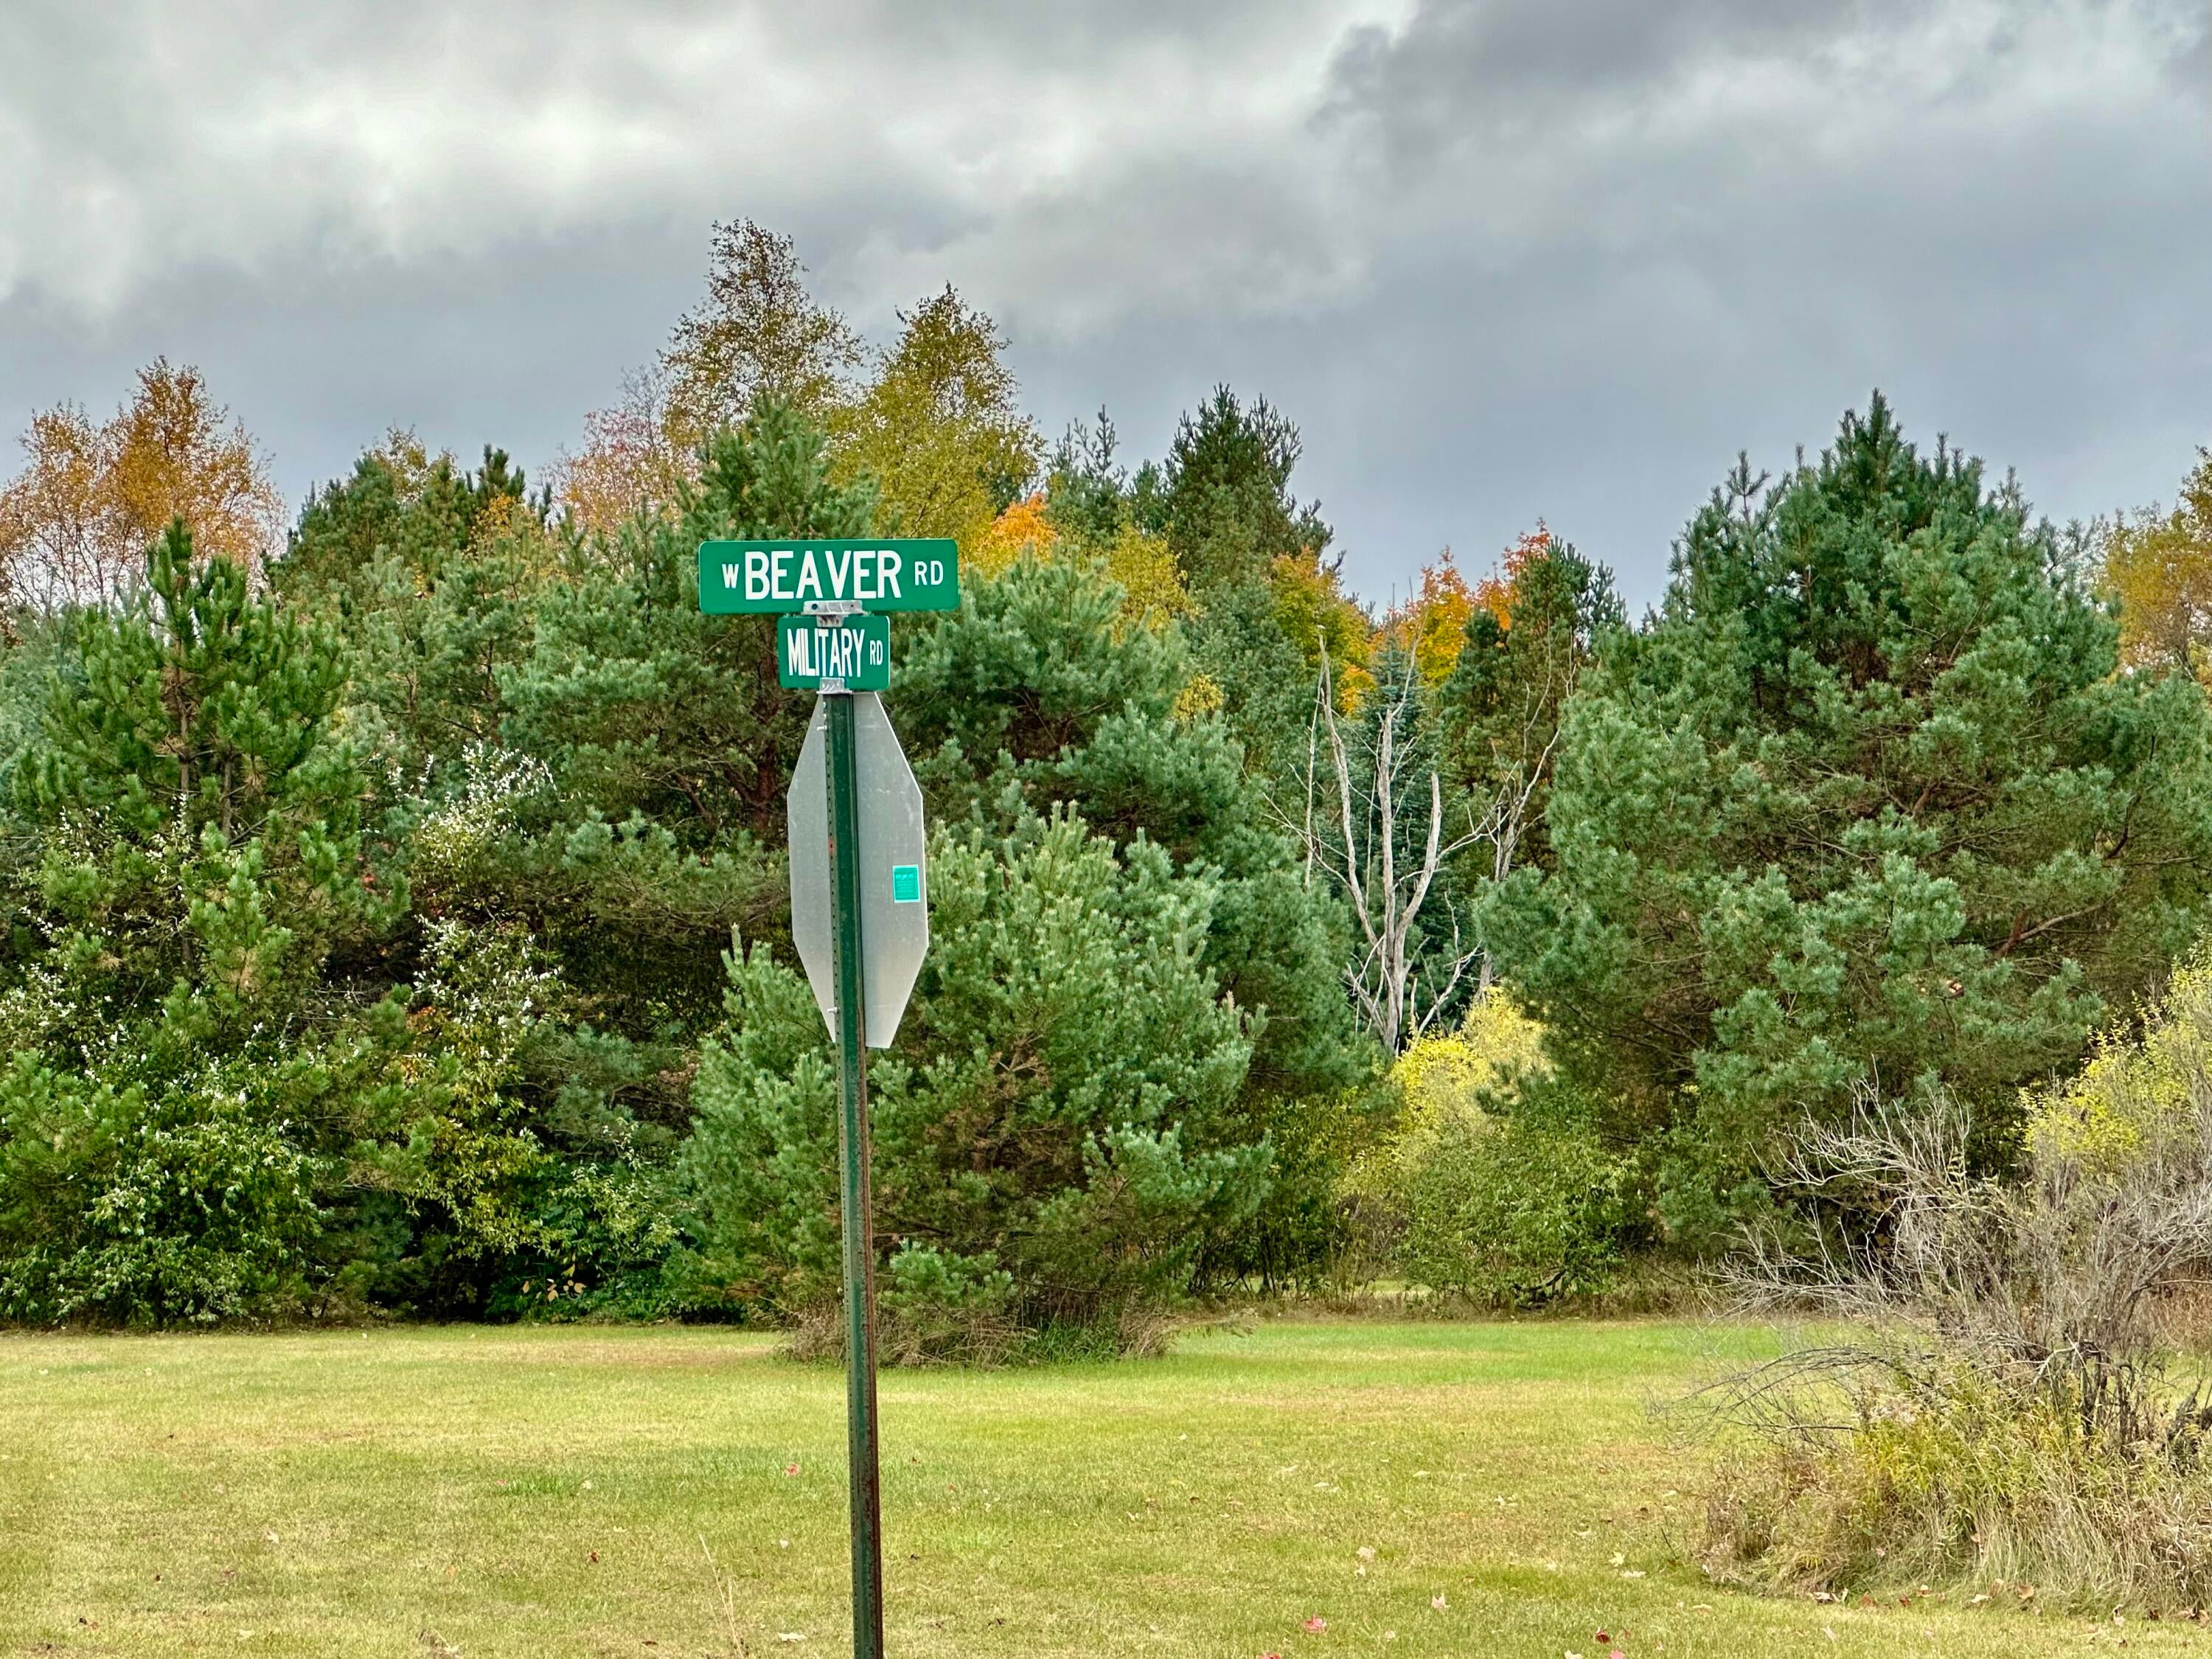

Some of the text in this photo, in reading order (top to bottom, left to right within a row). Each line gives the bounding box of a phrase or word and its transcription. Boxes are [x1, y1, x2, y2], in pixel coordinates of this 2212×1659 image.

[722, 550, 944, 599] W BEAVER RD
[787, 628, 883, 678] MILITARY RD
